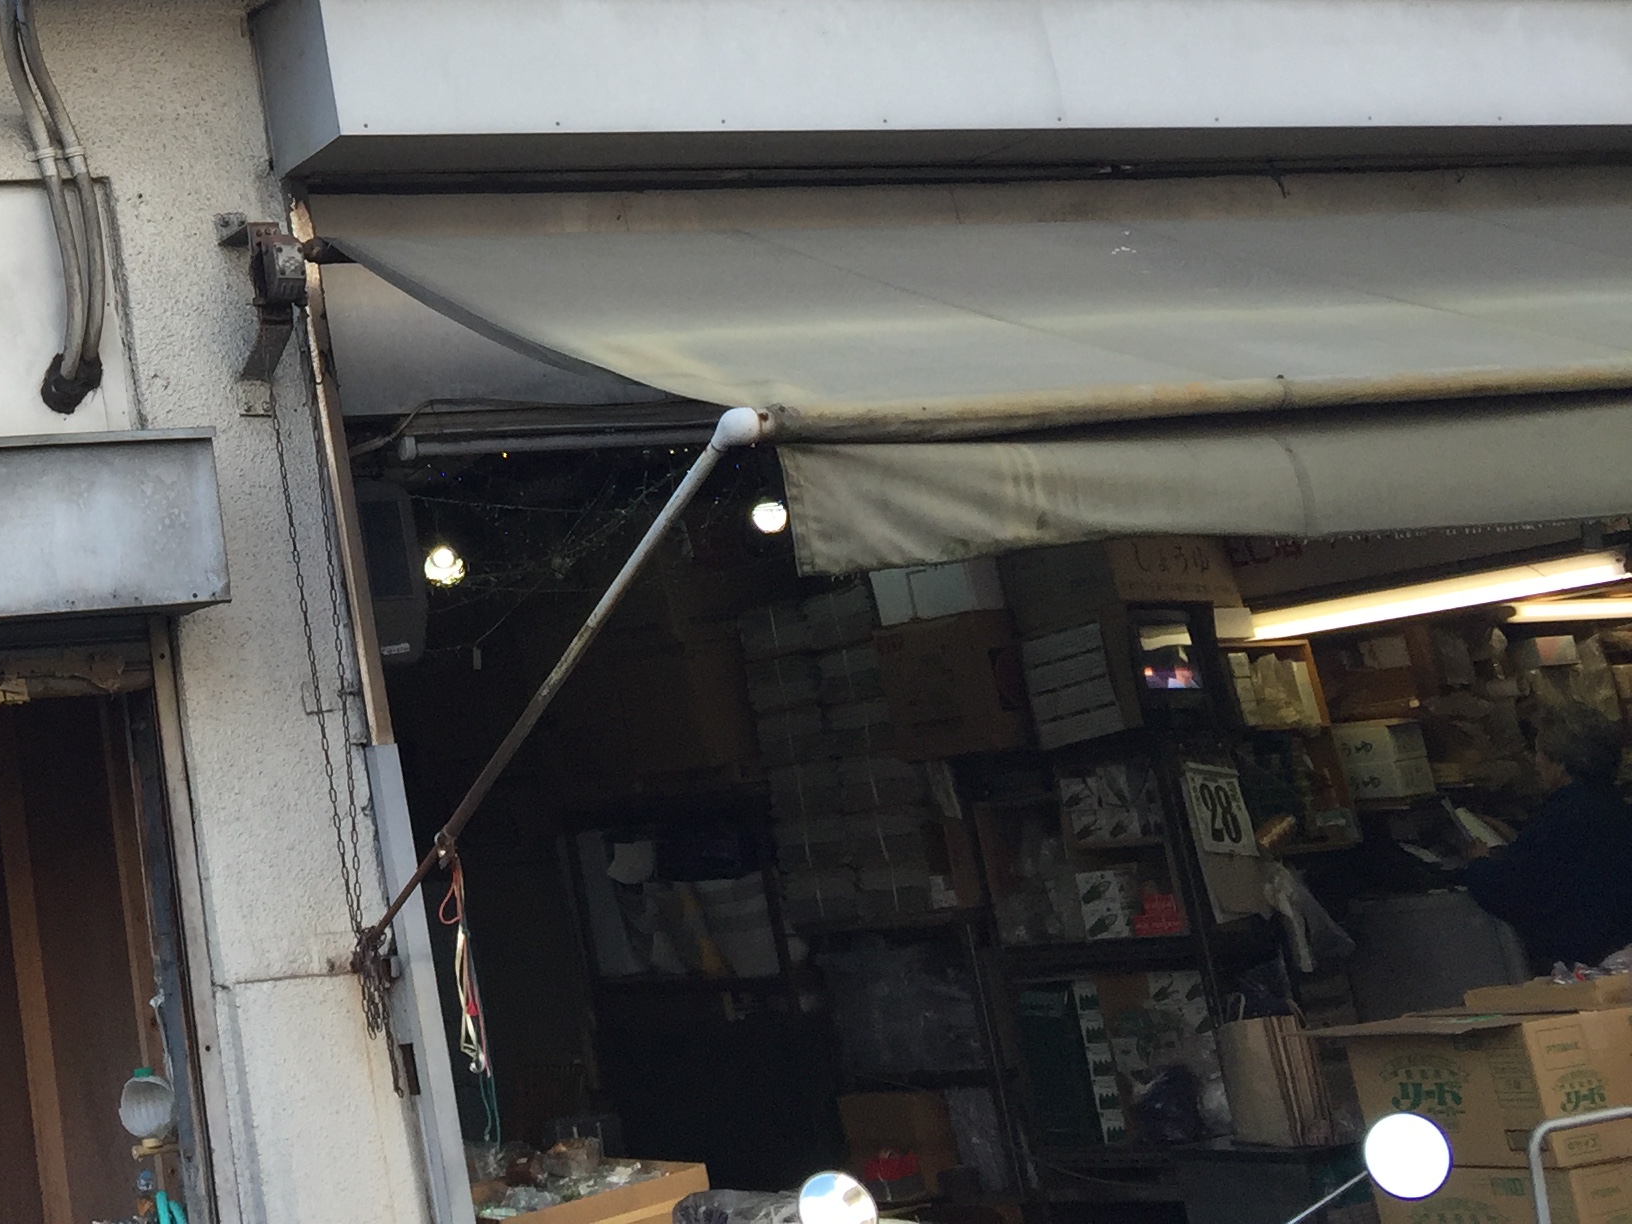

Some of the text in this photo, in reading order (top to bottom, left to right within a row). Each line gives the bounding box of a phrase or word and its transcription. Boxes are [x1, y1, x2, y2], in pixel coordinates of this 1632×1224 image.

[1199, 783, 1243, 844] 28
[1391, 1080, 1464, 1111] リード
